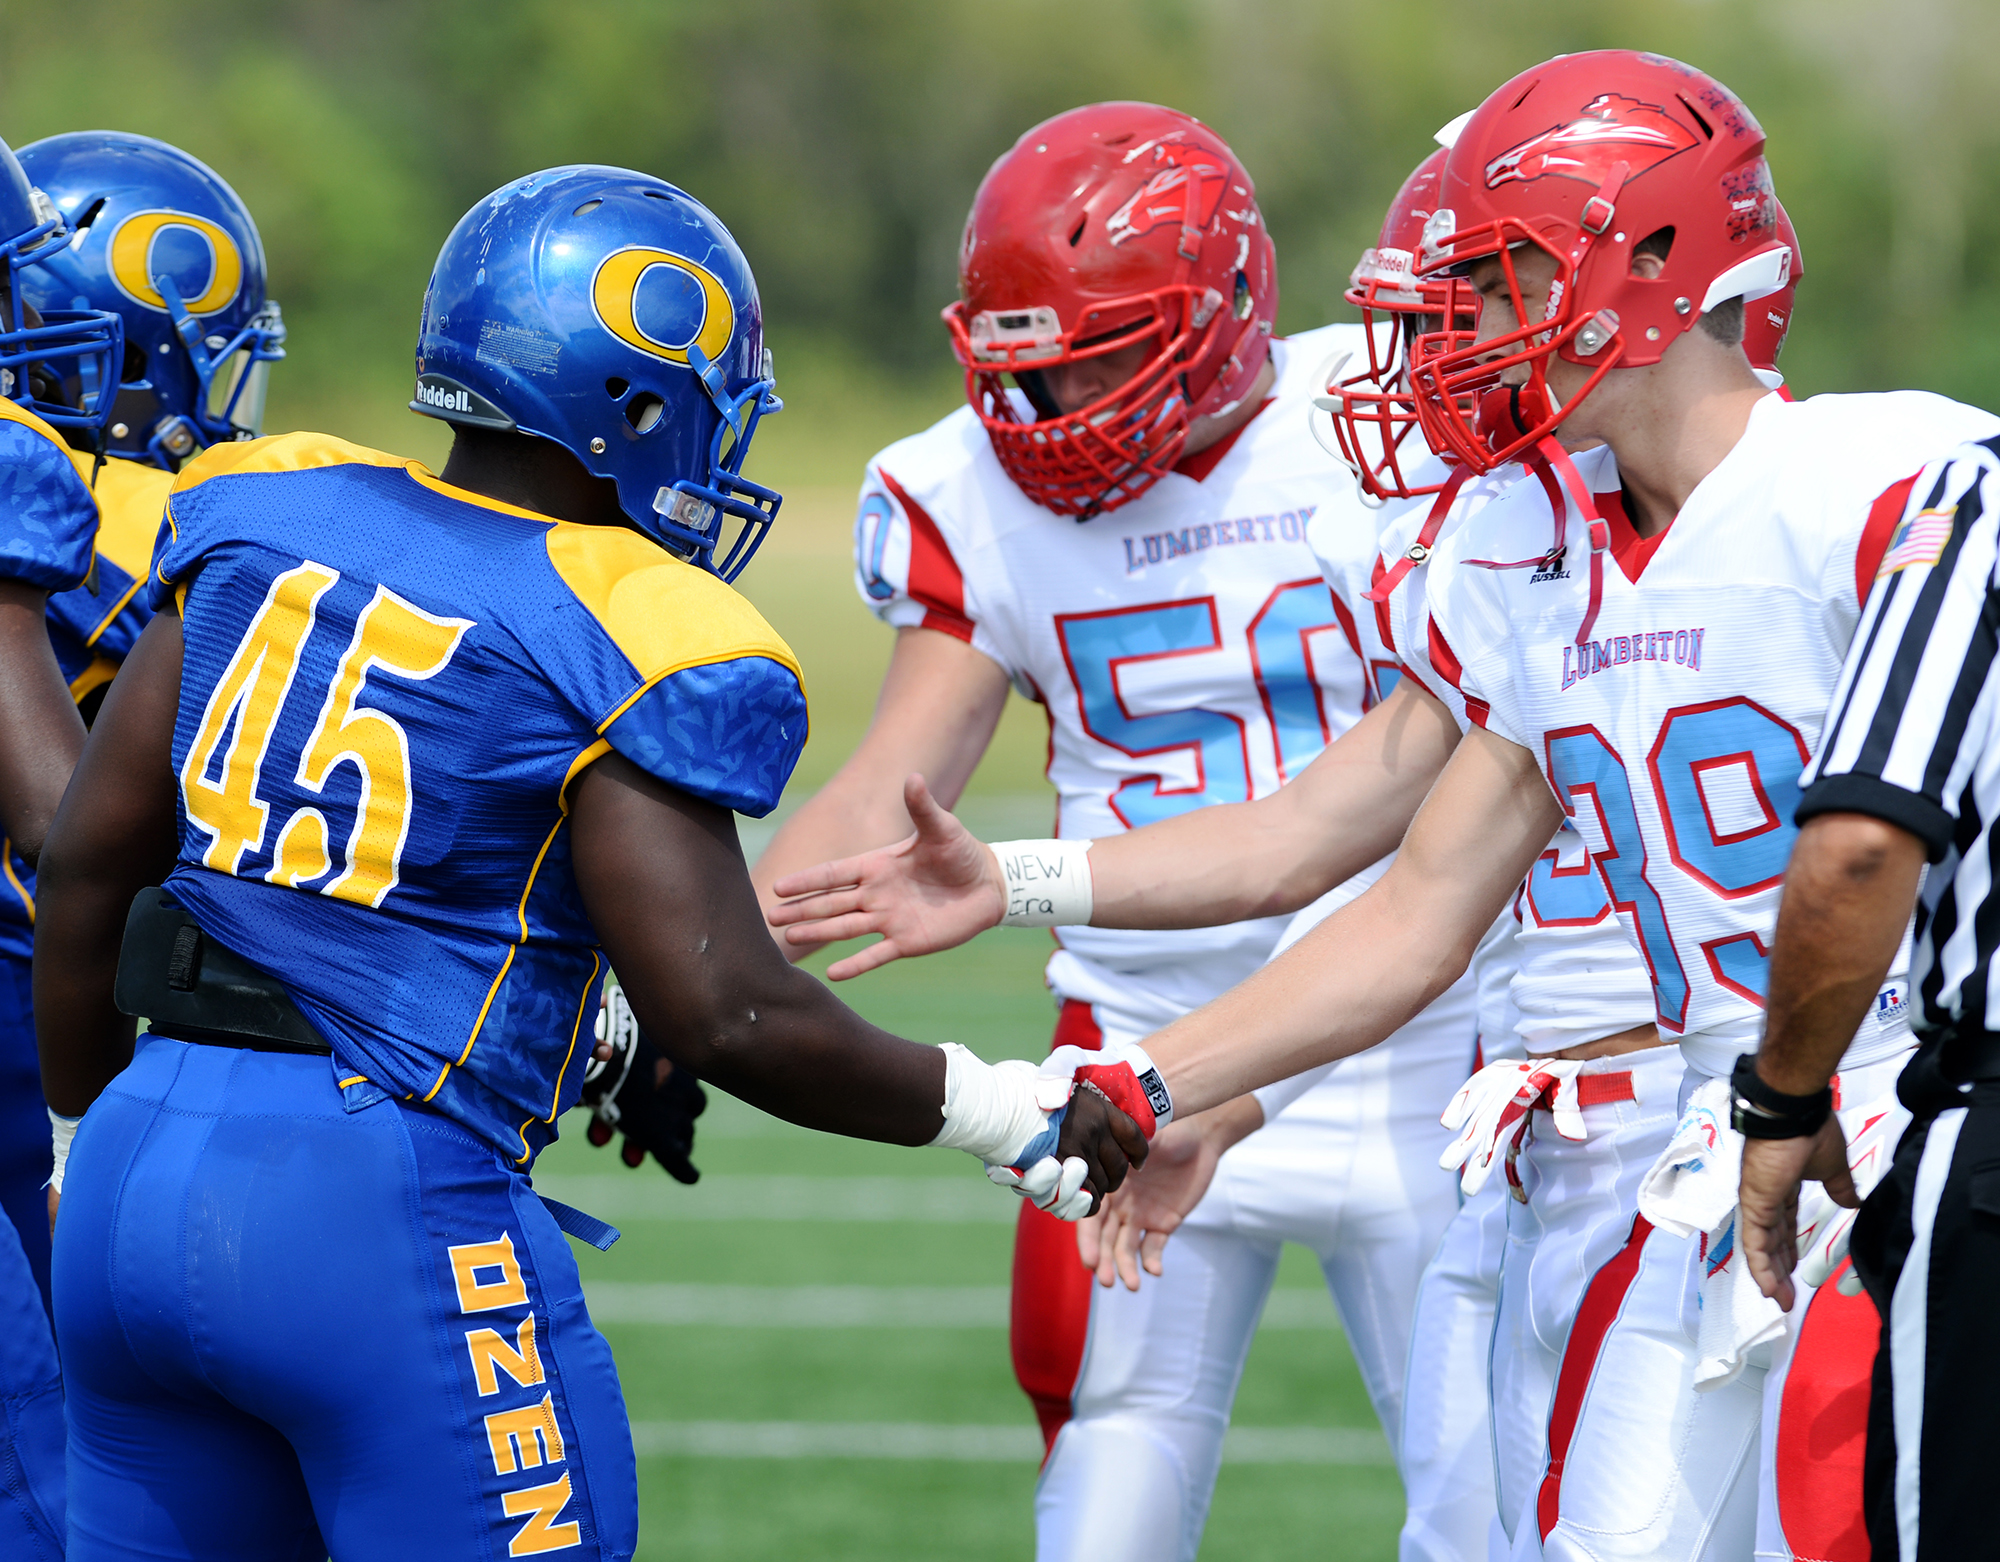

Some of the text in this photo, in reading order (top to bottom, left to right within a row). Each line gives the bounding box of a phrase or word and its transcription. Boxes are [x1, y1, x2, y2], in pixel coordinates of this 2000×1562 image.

[1529, 570, 1571, 585] RUSSELL
[1561, 628, 1705, 692] LUMBERTON
[180, 559, 478, 910] 45
[1005, 854, 1063, 881] NEW
[1008, 887, 1054, 916] Era
[448, 1231, 581, 1558] OZEN
